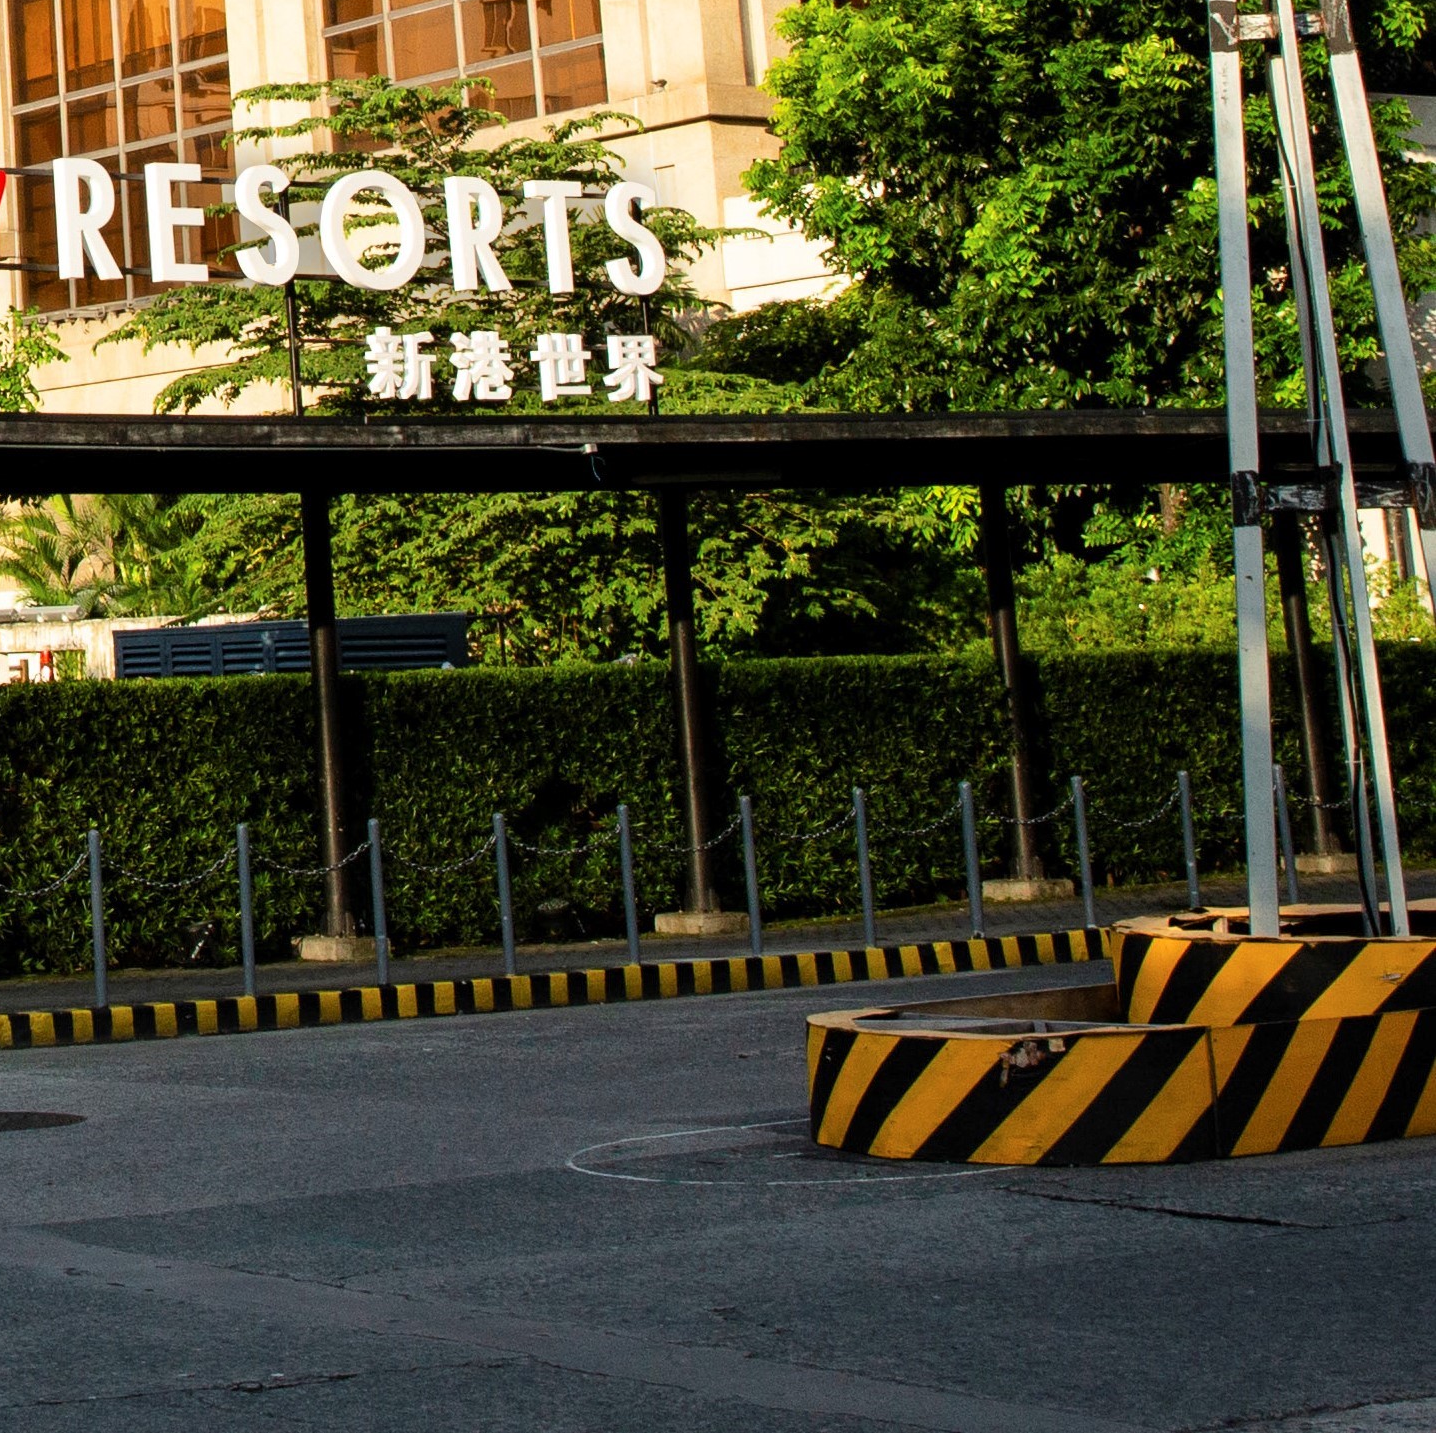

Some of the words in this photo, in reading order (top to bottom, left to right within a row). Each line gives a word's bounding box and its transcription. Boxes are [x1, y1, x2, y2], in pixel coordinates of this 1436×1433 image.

[53, 157, 666, 296] RESORTS
[364, 326, 665, 402] 新港世界
